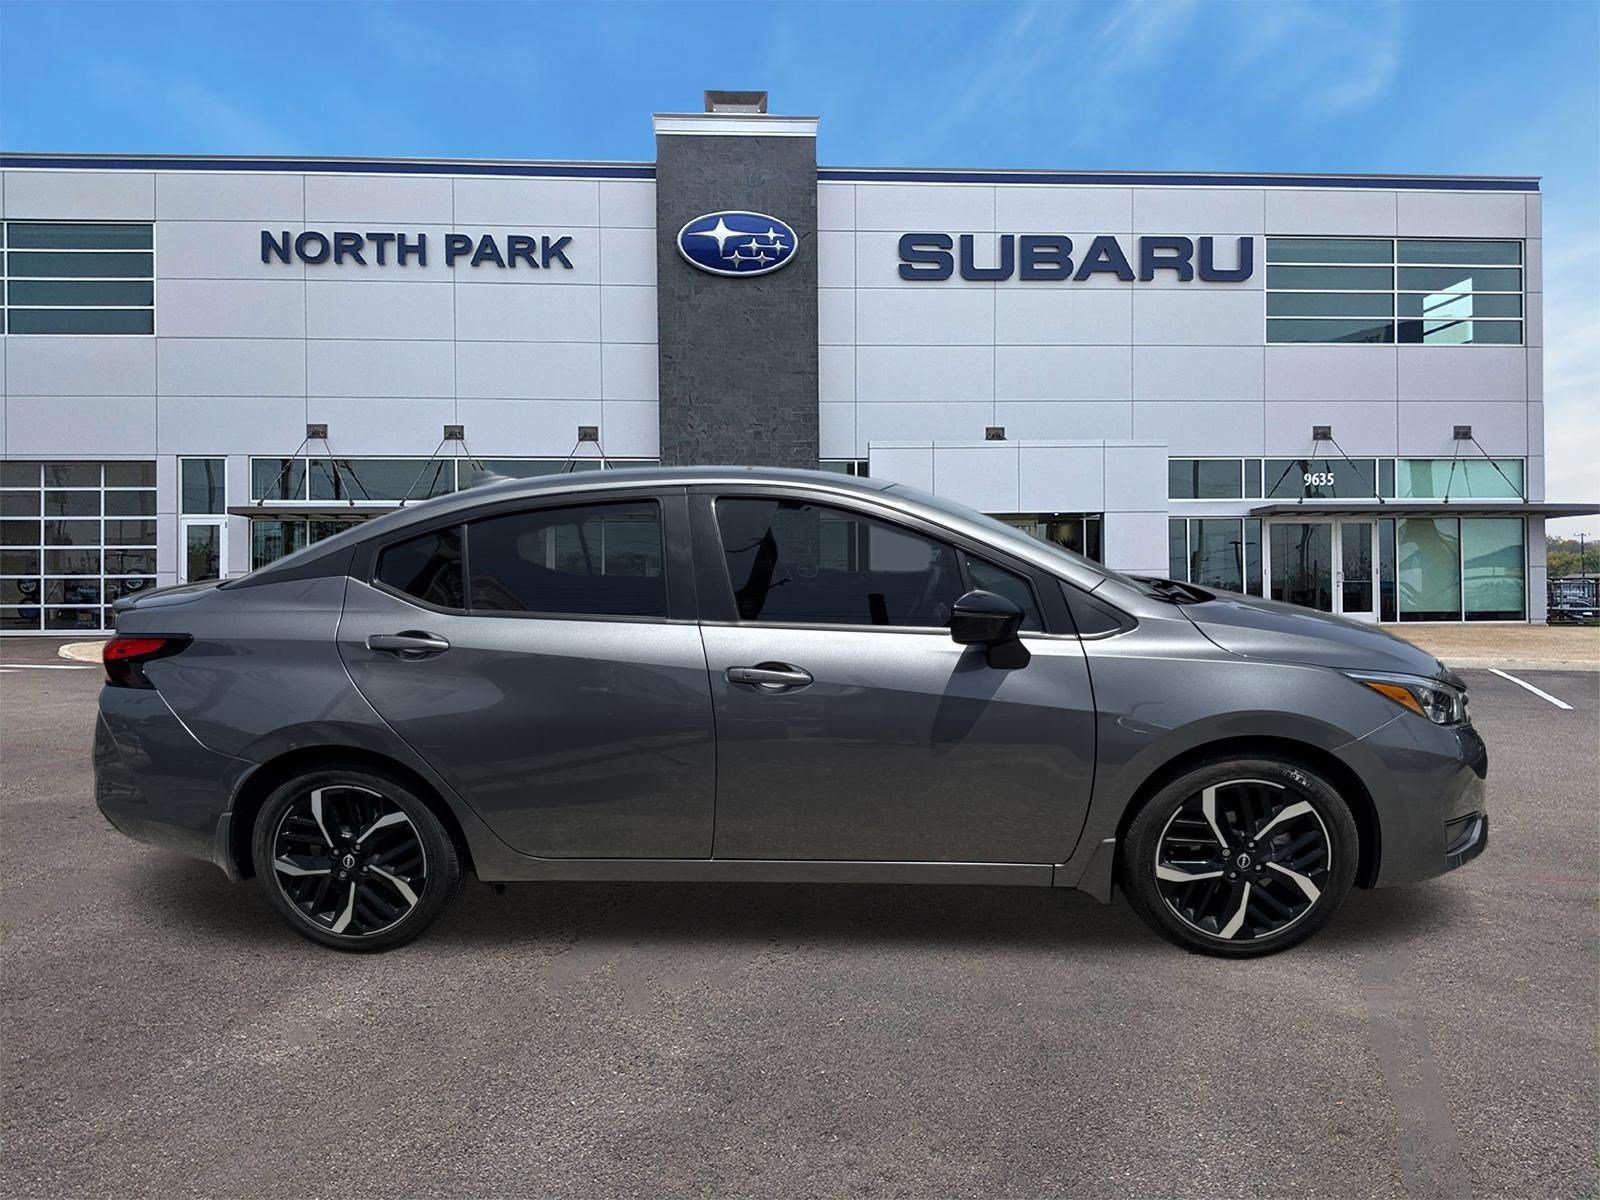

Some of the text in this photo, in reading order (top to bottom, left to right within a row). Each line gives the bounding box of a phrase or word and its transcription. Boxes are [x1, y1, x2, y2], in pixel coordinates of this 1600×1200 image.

[261, 231, 573, 269] NORTH PARK
[898, 234, 1254, 282] SUBARU
[1303, 473, 1335, 486] 9635
